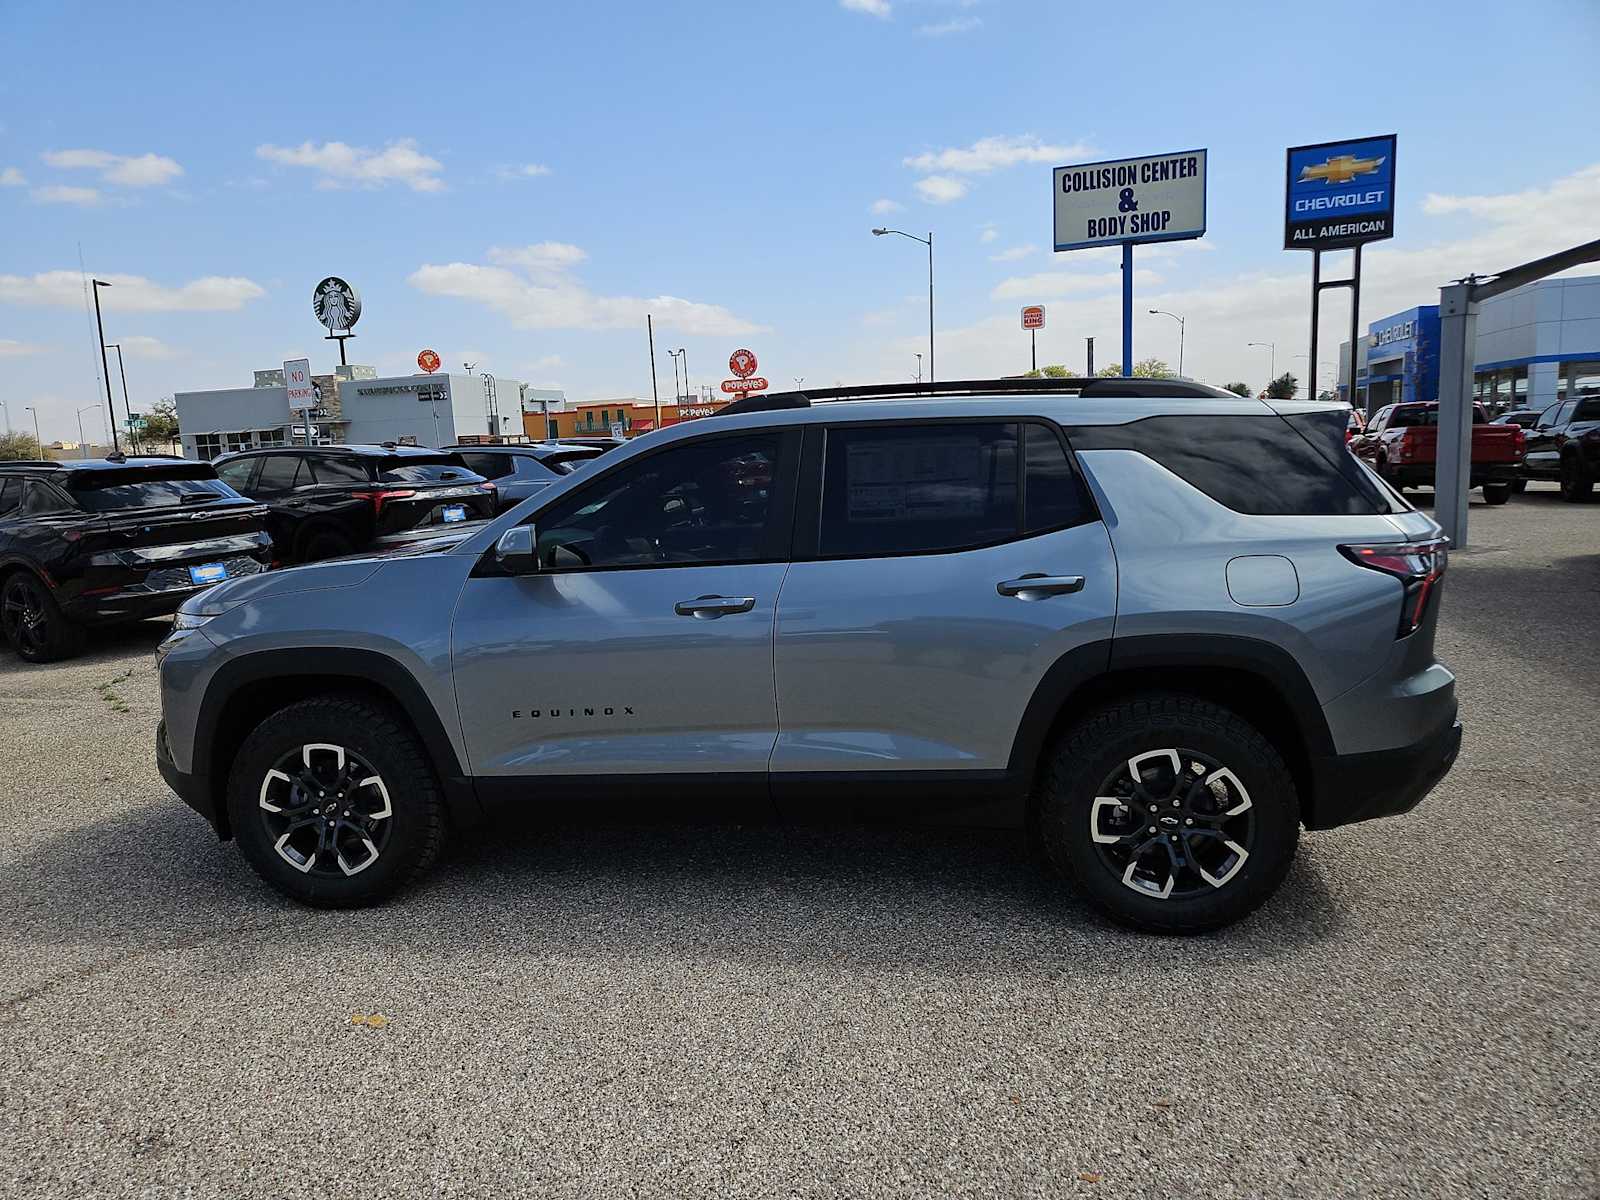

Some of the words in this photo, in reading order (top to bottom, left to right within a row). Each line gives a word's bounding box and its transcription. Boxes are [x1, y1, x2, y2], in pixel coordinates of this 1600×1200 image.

[1062, 165, 1137, 193] COLLISION
[1141, 157, 1197, 183] CENTER
[1118, 187, 1139, 213] &
[1295, 190, 1385, 212] CHEVROLET
[1088, 216, 1127, 238] BODY
[1130, 210, 1171, 233] SHOP
[1293, 228, 1317, 240] ALL
[1319, 220, 1385, 238] AMERICAN
[291, 371, 304, 382] NO
[288, 389, 311, 398] PARKING
[512, 706, 634, 719] EQUINOX
